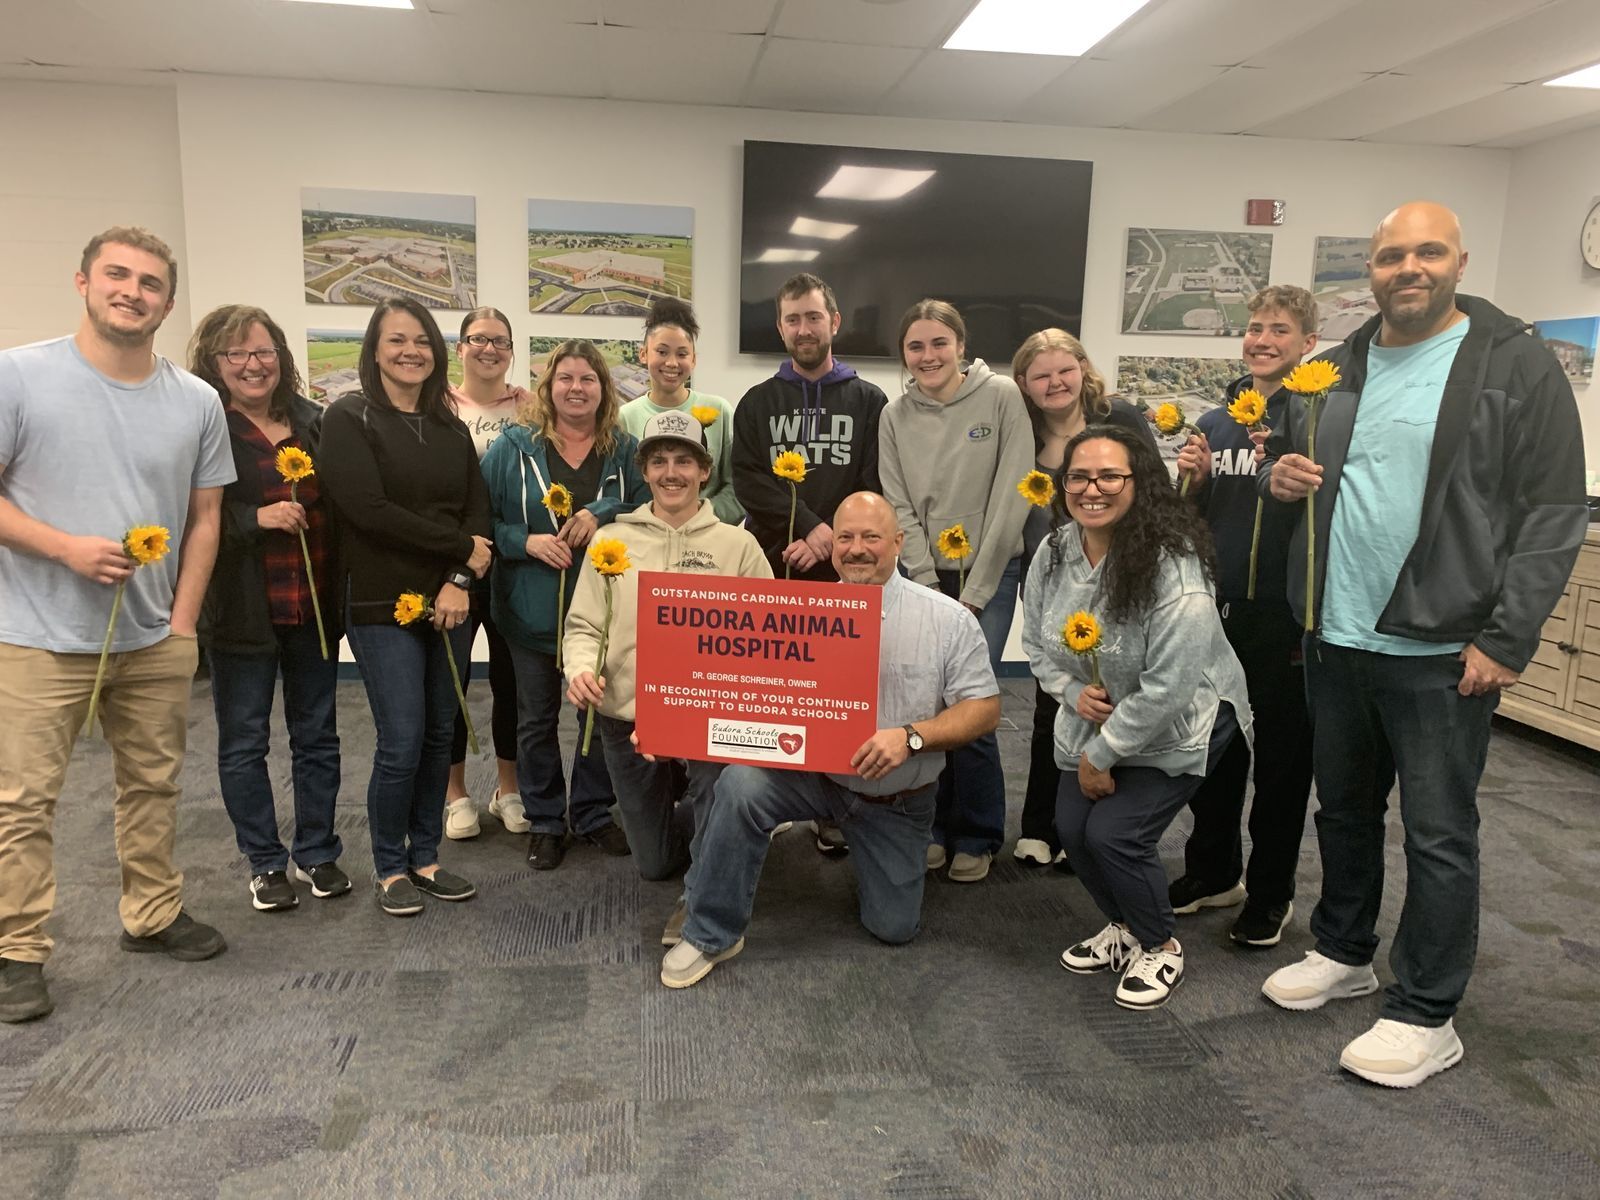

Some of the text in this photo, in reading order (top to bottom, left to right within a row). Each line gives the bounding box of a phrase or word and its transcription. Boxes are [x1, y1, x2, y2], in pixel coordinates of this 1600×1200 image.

[769, 414, 854, 444] WILD
[1211, 448, 1258, 478] FAM
[652, 588, 868, 609] OUTSTANDING CARDINAL PARTNER
[657, 606, 861, 638] EUDORA ANIMAL
[698, 635, 815, 662] HOSPITAL
[692, 671, 817, 688] DR. GEORGE SCHREINER, OWNER
[644, 684, 870, 710] IN RECOGNITION OF YOUR CONTINUED
[664, 697, 848, 720] SUPPORT TO EUDORA SCHOOLS
[712, 723, 778, 738] Eudora Schools
[712, 732, 778, 746] FOUNDATION
